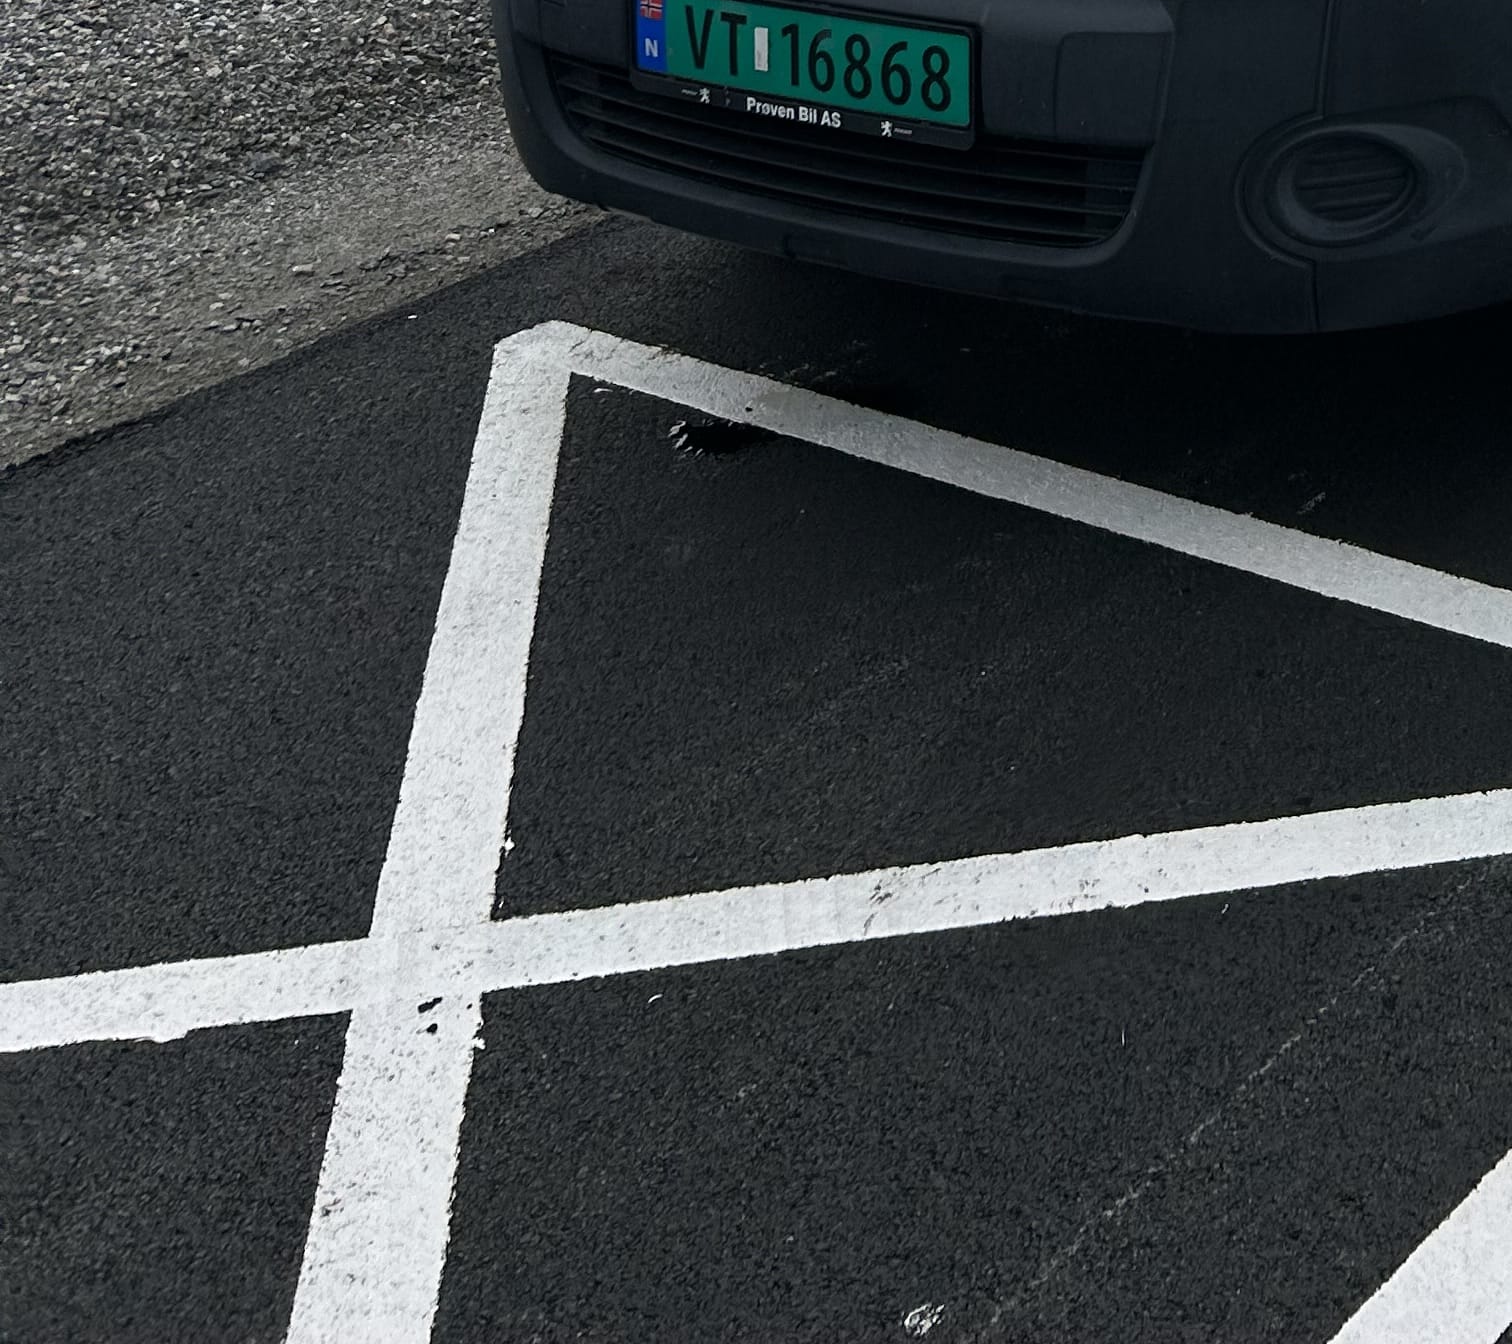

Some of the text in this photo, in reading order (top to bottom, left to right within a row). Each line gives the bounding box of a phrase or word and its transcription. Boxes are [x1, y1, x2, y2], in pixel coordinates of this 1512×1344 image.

[645, 38, 659, 59] N
[684, 4, 952, 113] VT 16868
[746, 96, 842, 129] Prøven Bil AS
